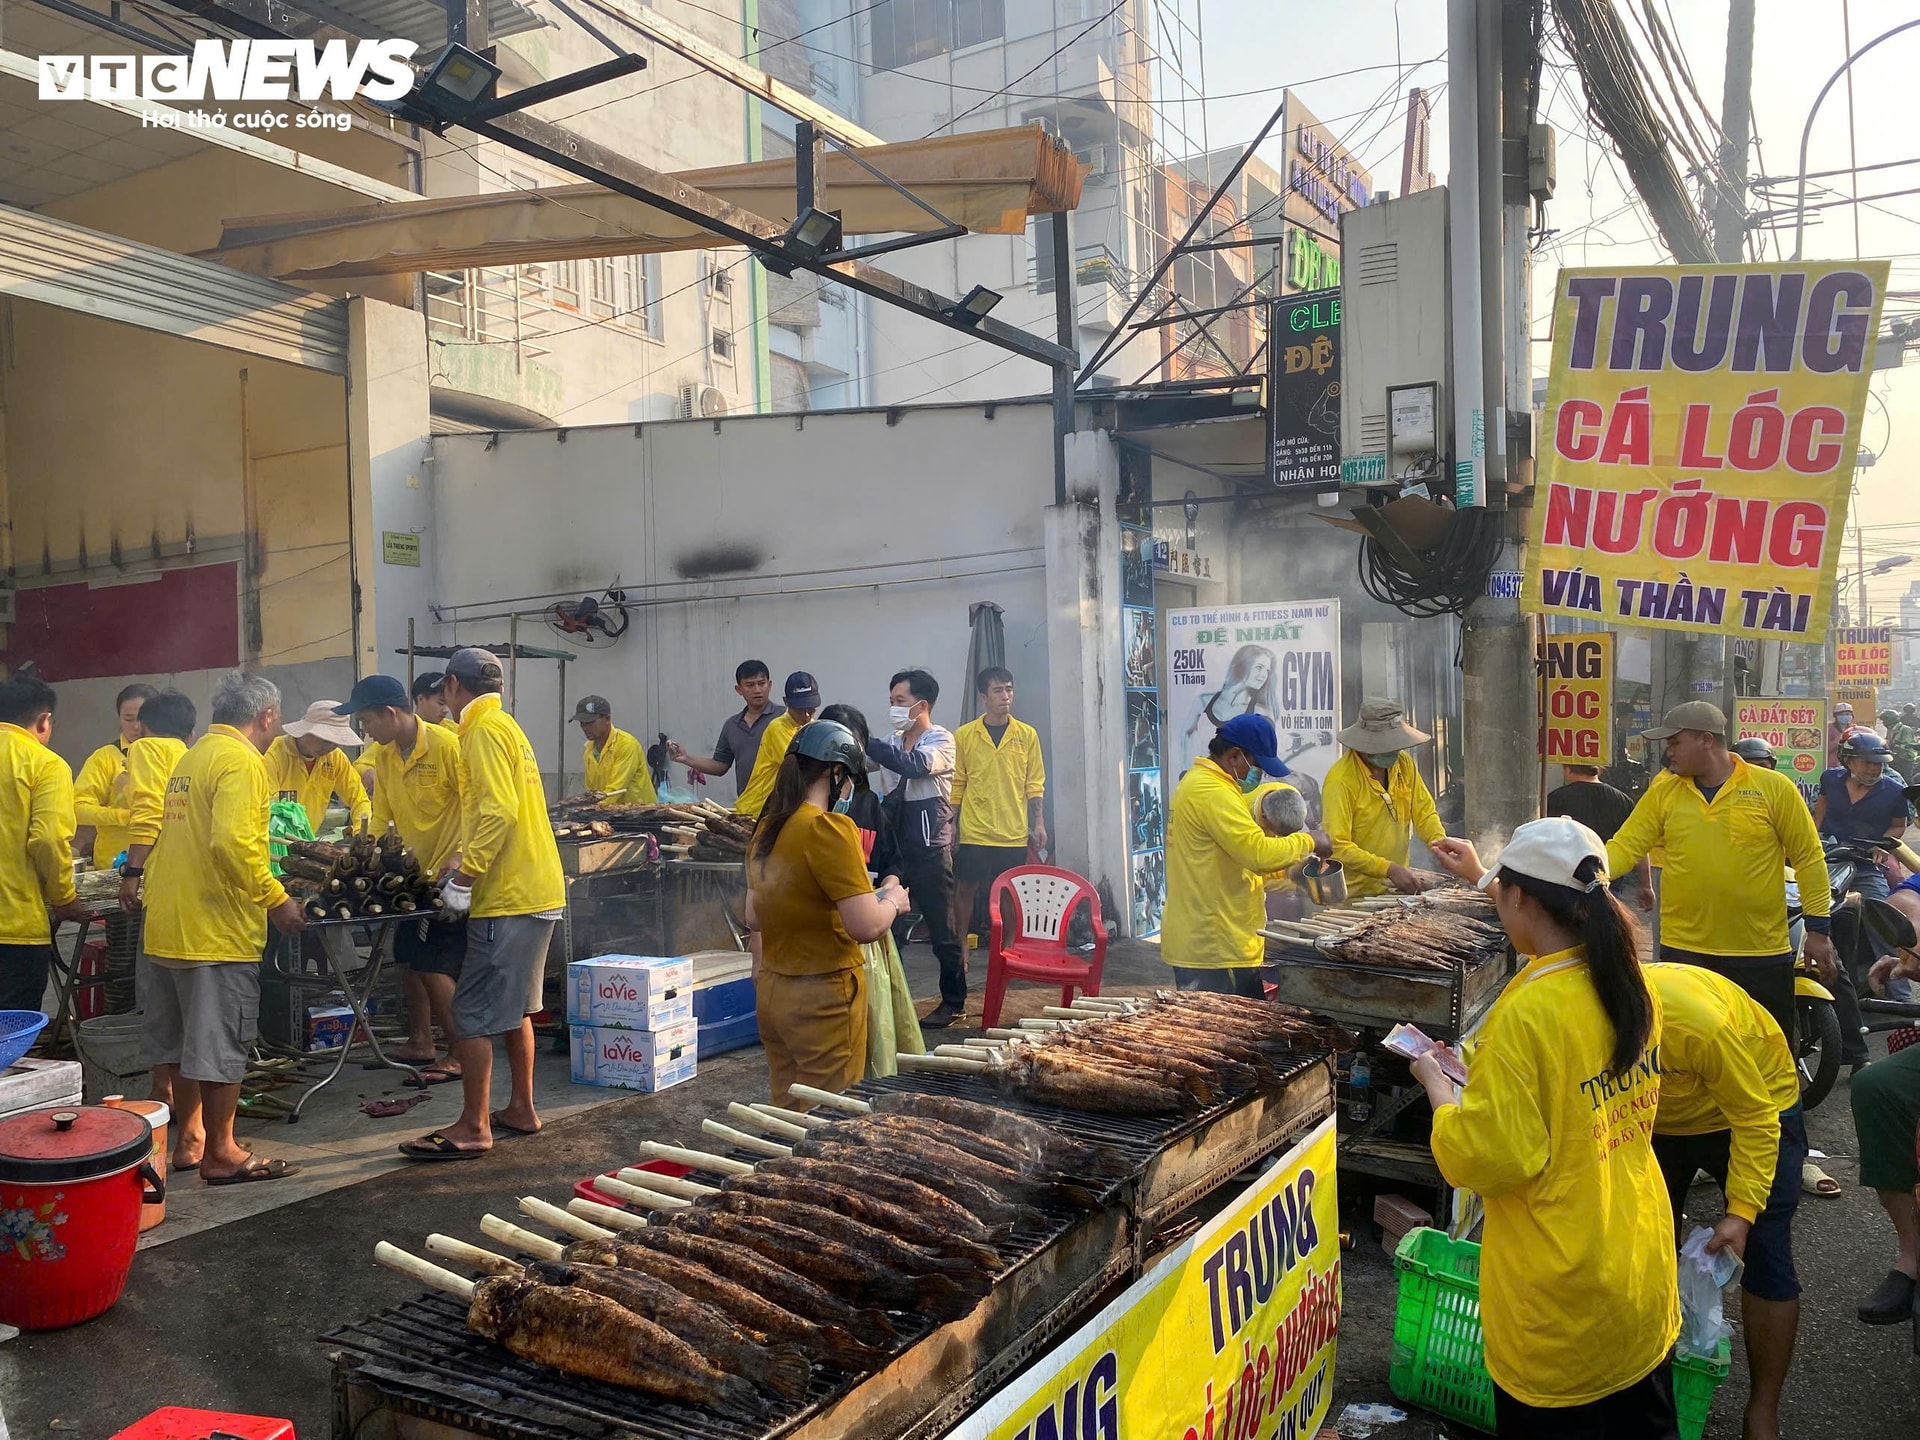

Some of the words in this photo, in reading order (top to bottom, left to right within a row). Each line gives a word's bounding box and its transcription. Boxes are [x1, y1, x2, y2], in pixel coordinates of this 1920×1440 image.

[1567, 272, 1873, 373] TRUNG
[1284, 334, 1333, 375] ĐỆ
[1555, 386, 1650, 466] CÁ
[1680, 388, 1846, 474] LÓC
[1280, 466, 1314, 481] NHẬN
[1321, 465, 1341, 478] HỌ
[1543, 479, 1827, 569] NƯỚNG
[1541, 567, 1603, 613] VÍA
[1615, 573, 1726, 625] THẦN
[1741, 586, 1812, 633] TÀI
[1172, 616, 1188, 625] CLB
[1253, 610, 1289, 621] FITNESS
[1292, 608, 1312, 619] NAM
[1197, 628, 1228, 645] ĐỆ
[1237, 621, 1303, 642] NHẤT
[1838, 628, 1890, 644] TRUNG
[1838, 647, 1856, 660] CÁ
[1861, 647, 1889, 660] LÓC
[1838, 662, 1889, 675] NƯỚNG
[1174, 675, 1178, 685] 1
[1182, 673, 1205, 685] Tháng
[1174, 649, 1205, 670] 250K
[1282, 652, 1334, 711] GYM
[1837, 691, 1871, 700] TRUNG
[1315, 716, 1333, 729] 10M
[1739, 704, 1756, 722] GÀ
[1760, 702, 1786, 723] ĐẤT
[1790, 705, 1814, 723] SÉT
[1203, 1168, 1319, 1355] TRUNG
[1268, 1260, 1340, 1416] NƯỚNG
[1015, 1352, 1118, 1440] NG
[1300, 1358, 1326, 1431] QUÝ
